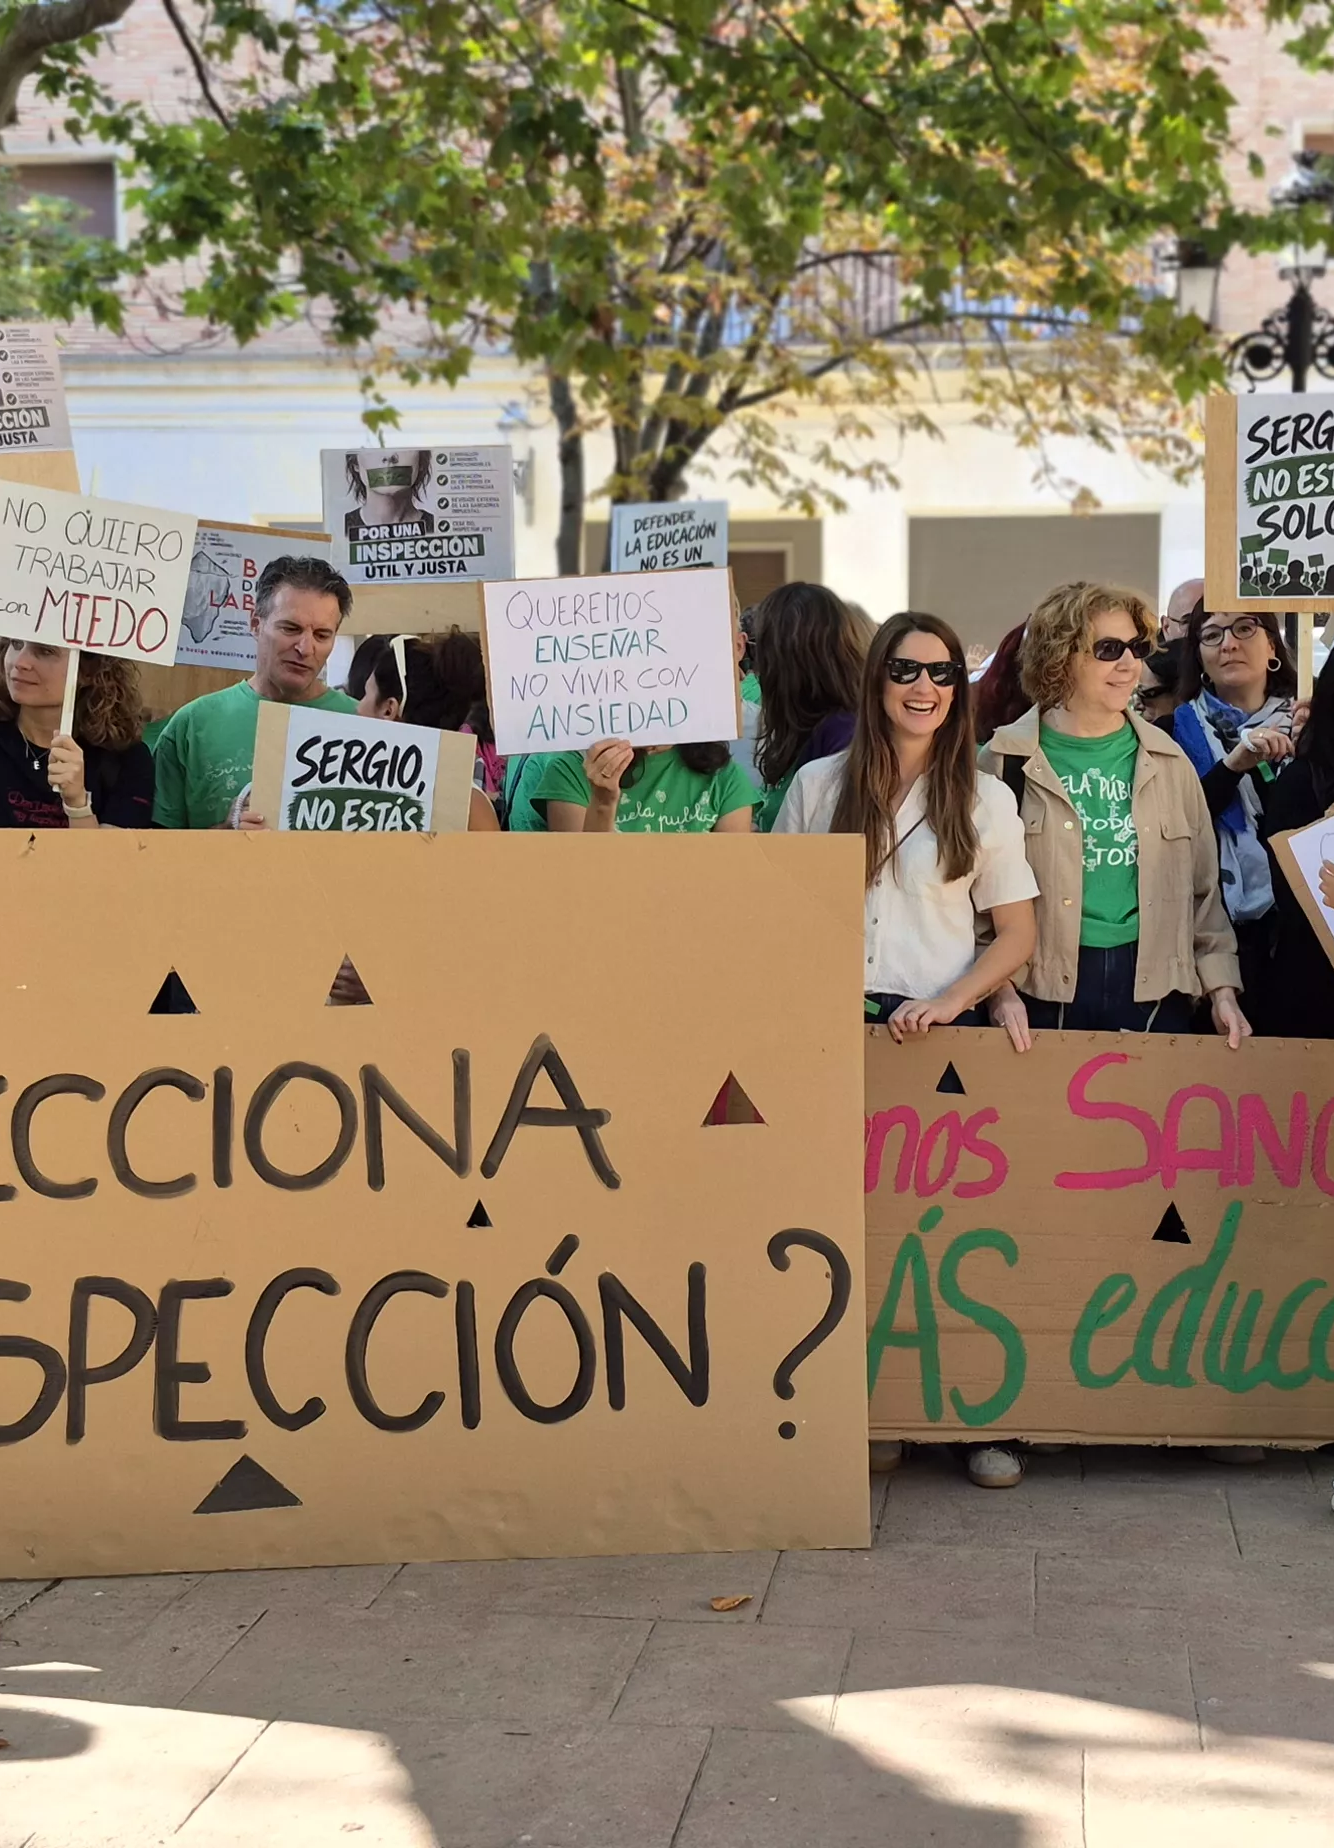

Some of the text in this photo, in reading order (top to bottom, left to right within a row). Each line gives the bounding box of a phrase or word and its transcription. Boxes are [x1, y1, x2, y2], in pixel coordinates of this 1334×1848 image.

[1253, 468, 1291, 501] NO
[3, 497, 183, 562] NO QUIERO
[359, 523, 422, 540] POR UNA
[625, 518, 717, 557] LA EDUCACIÓN
[634, 509, 695, 534] DEFENDER
[356, 536, 479, 562] INSPECCIÓN
[639, 544, 703, 570] NO ES UN
[15, 544, 157, 596] TRABAJAR
[365, 560, 467, 578] ÚTIL Y JUSTA
[35, 586, 169, 653] MIEDO
[506, 590, 663, 631] QUEREMOS
[535, 627, 667, 663] ENSEÑAR
[511, 664, 699, 701] NO VIVIR CON
[527, 697, 688, 741] ANSIEDAD
[291, 735, 426, 797] SERGIO,
[295, 796, 418, 831] NO ESTÁS
